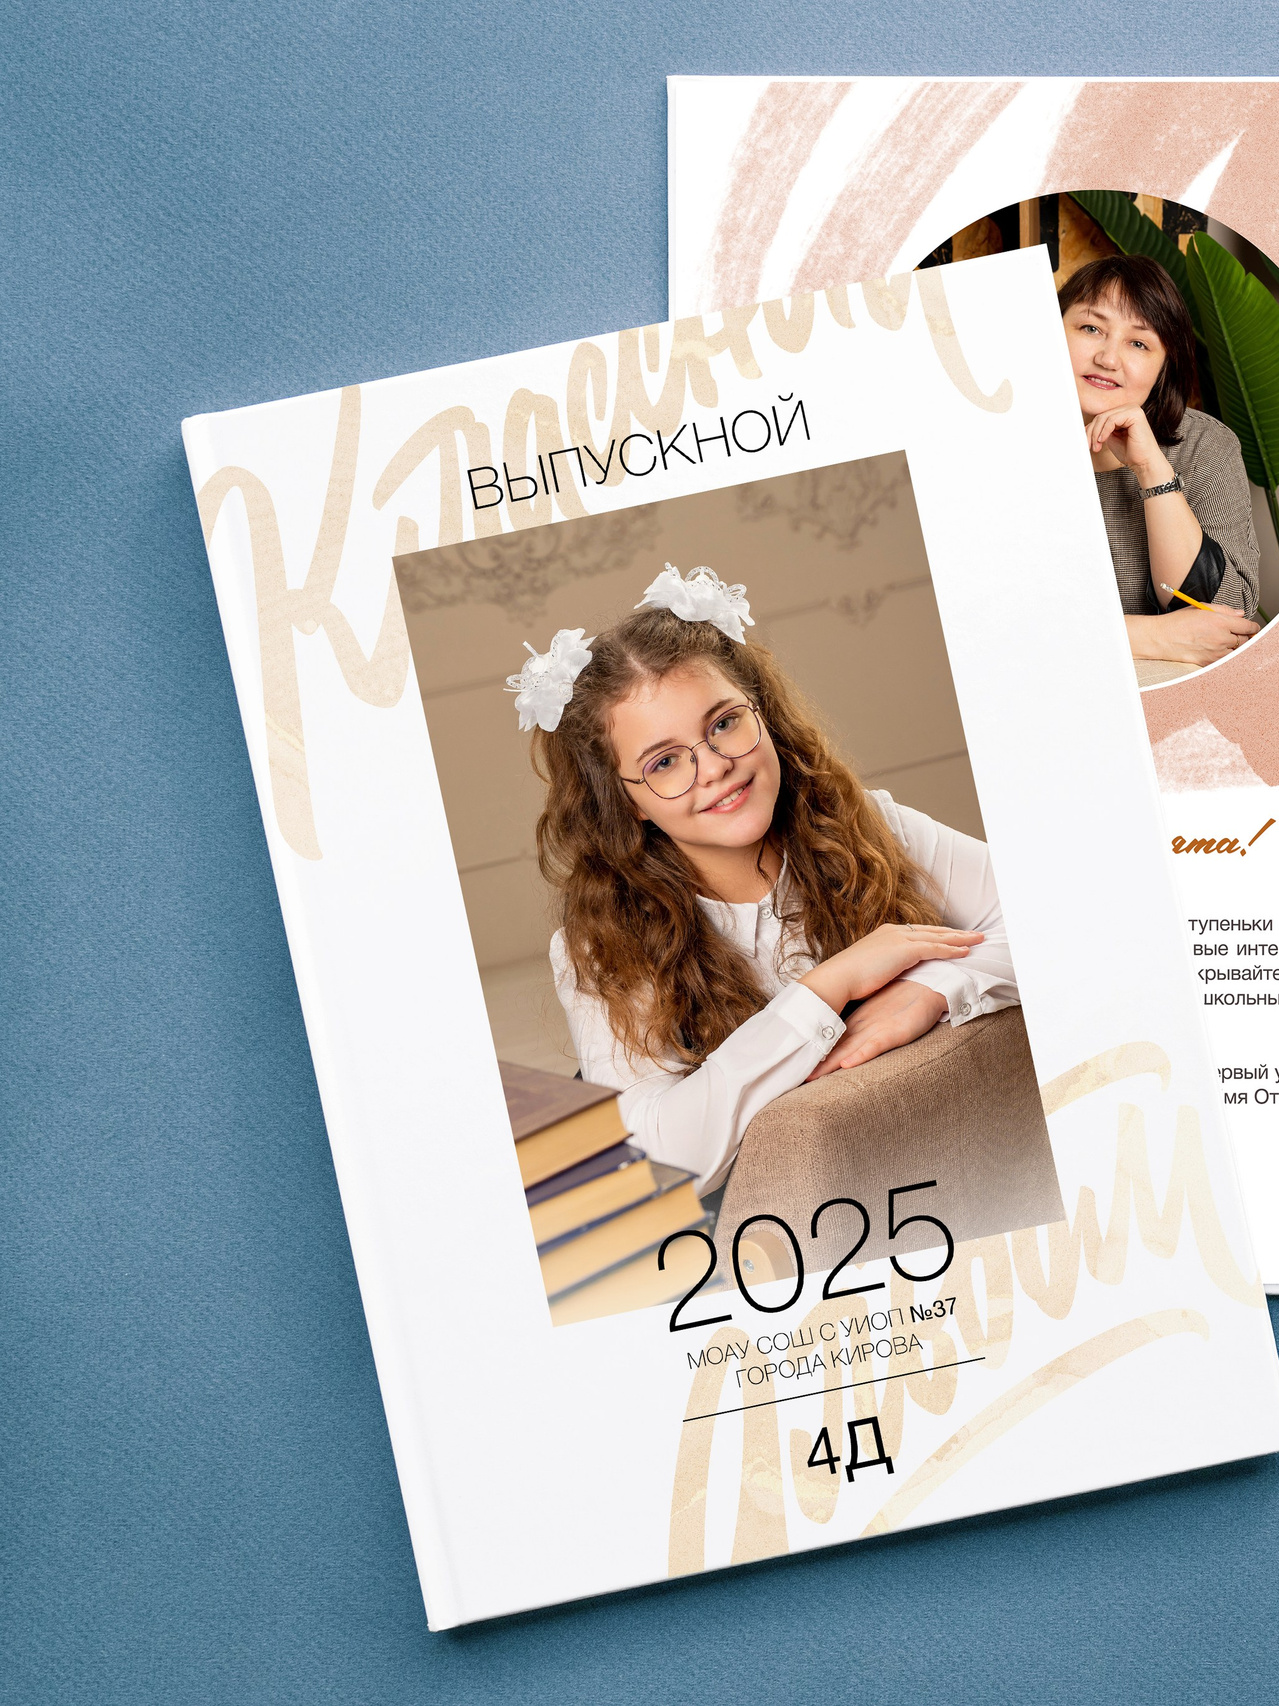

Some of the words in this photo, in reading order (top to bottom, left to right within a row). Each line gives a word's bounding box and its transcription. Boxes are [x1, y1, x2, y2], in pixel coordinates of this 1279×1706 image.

[467, 392, 811, 510] ВЫПУСКНОЙ
[1187, 919, 1273, 935] тупеньки
[1193, 943, 1229, 956] вые
[1217, 1064, 1268, 1084] рвый
[657, 1180, 954, 1332] 2025
[686, 1339, 750, 1370] МОАУ
[756, 1326, 814, 1356] СОШ
[819, 1322, 837, 1342] С
[839, 1307, 905, 1338] УИОП
[909, 1296, 957, 1324] №37
[735, 1353, 828, 1388] ГОРОДА
[830, 1333, 924, 1369] КИРОВА
[807, 1415, 895, 1483] 4Д
